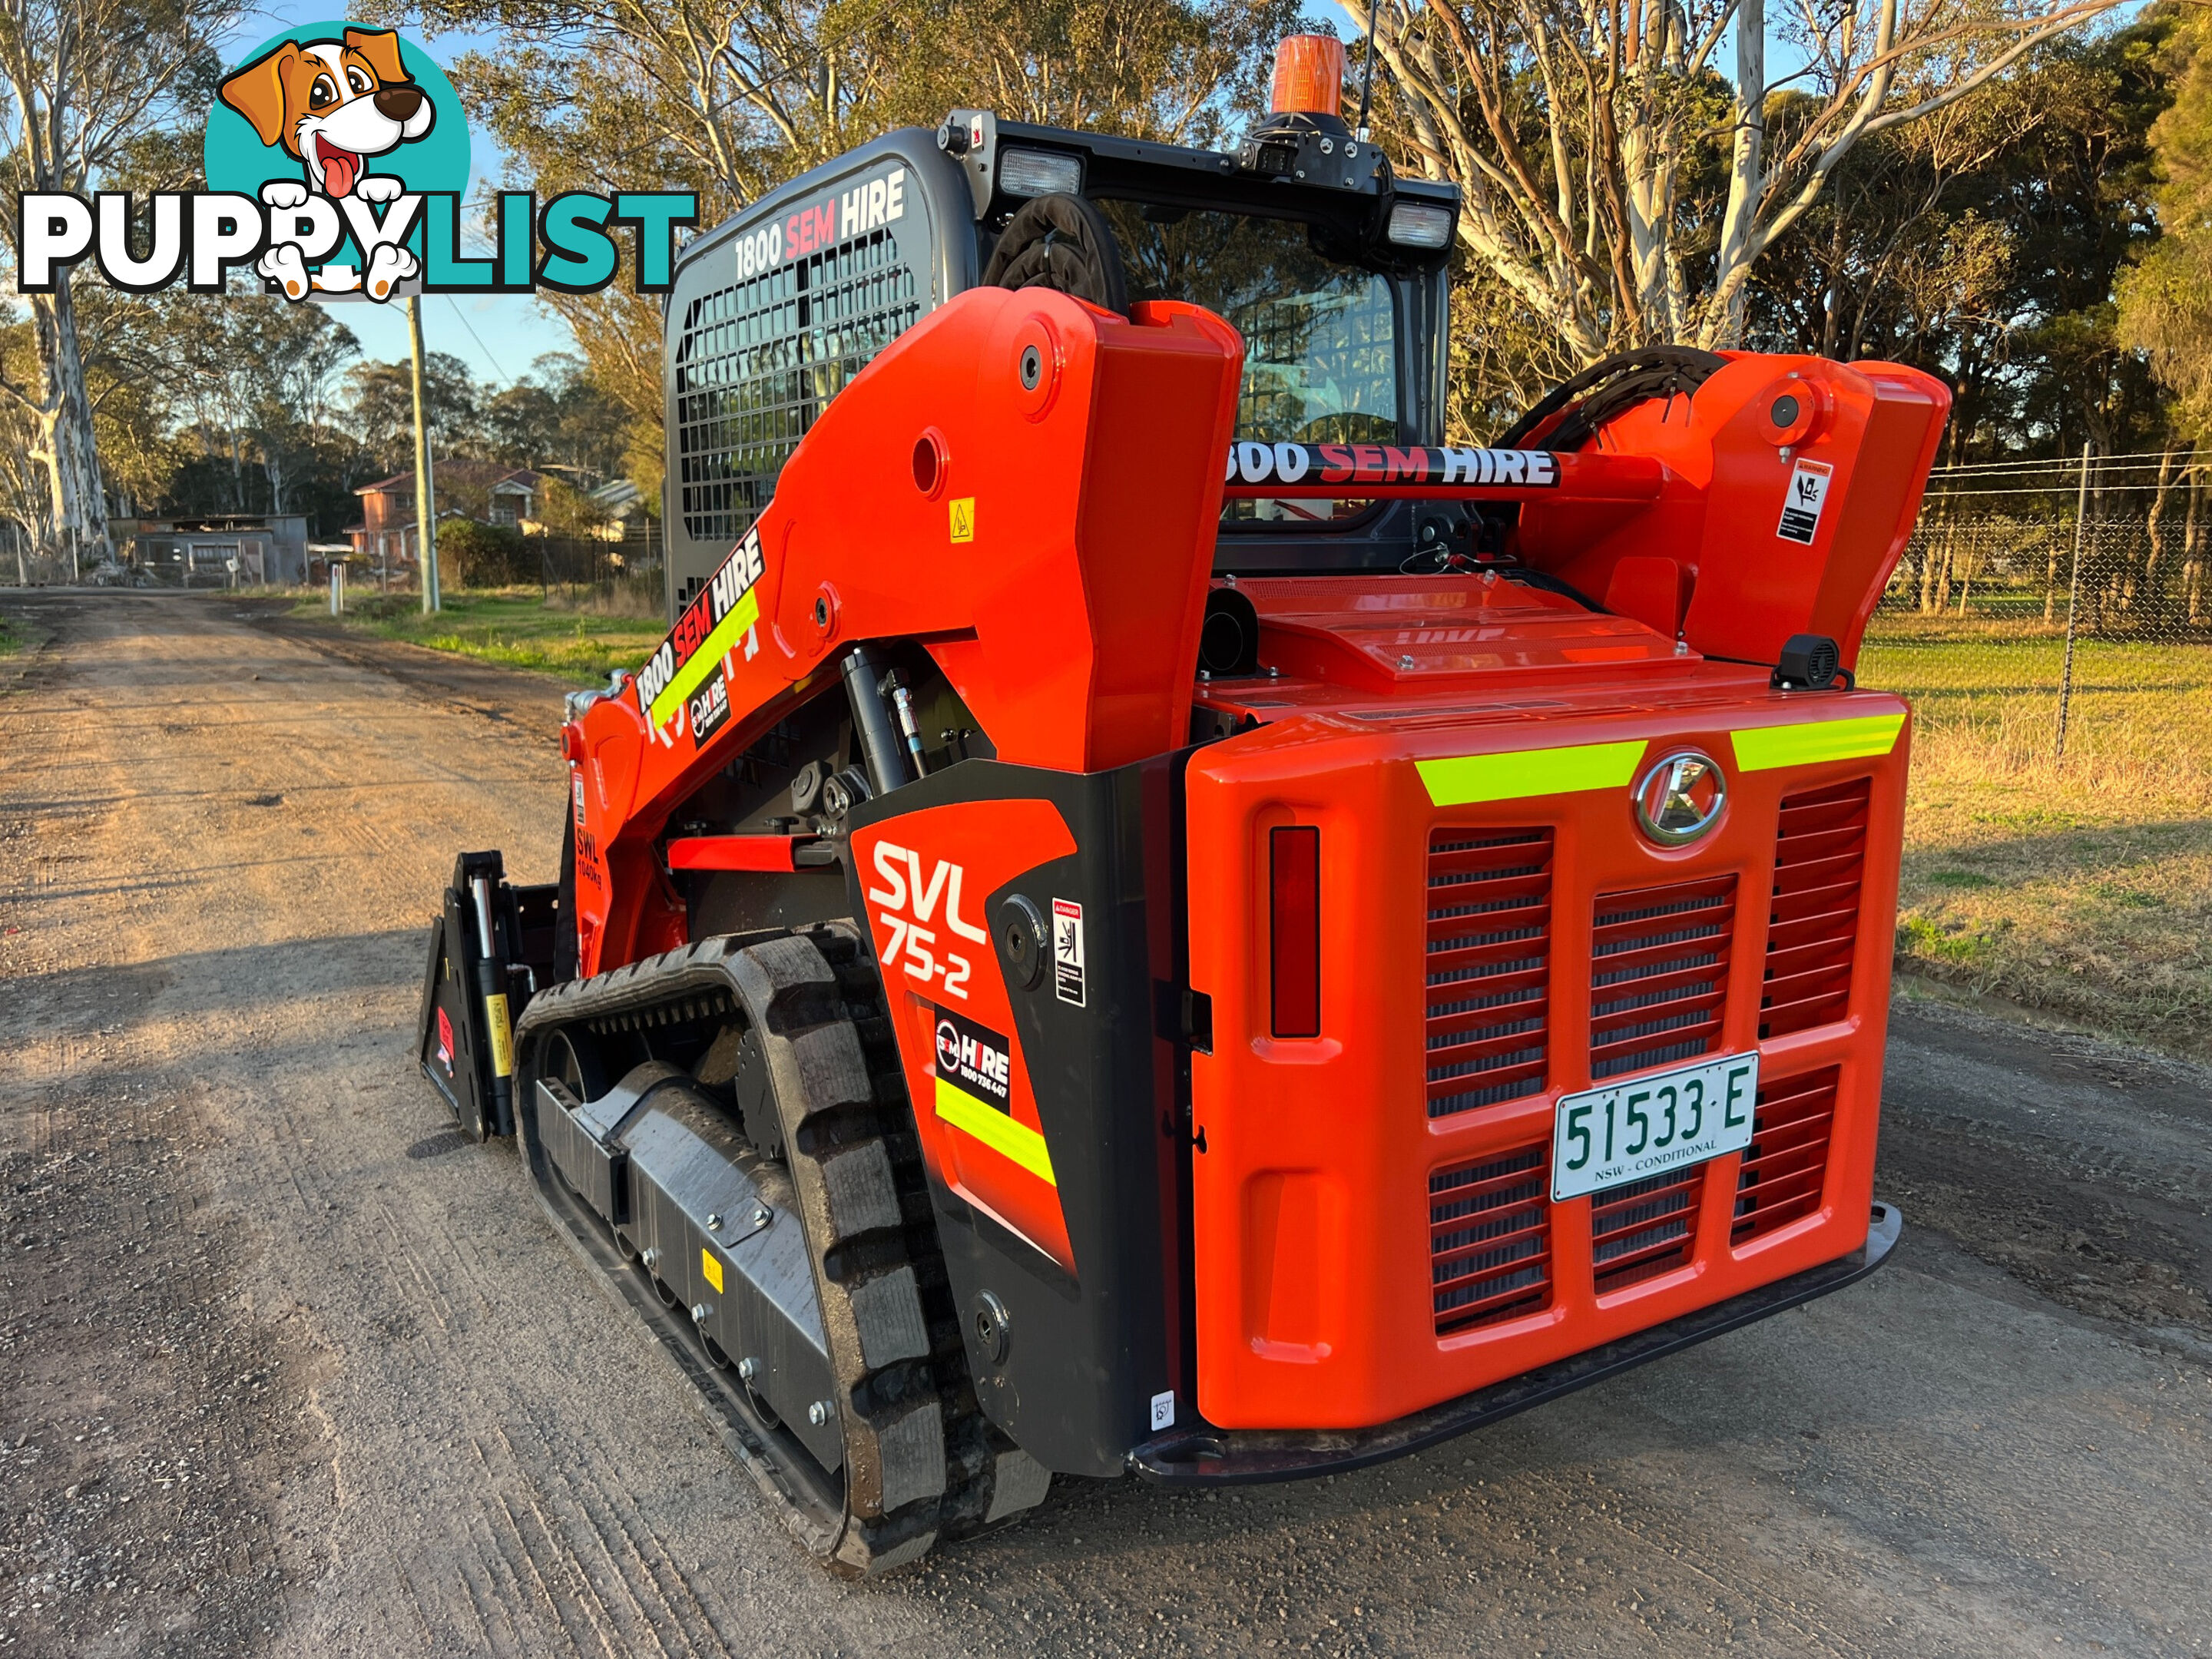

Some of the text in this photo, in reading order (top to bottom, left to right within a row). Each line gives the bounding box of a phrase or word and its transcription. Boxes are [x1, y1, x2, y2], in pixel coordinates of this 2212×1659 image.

[735, 168, 905, 280] 1800 SEM HIRE
[1318, 442, 1429, 482] SEM
[1439, 446, 1555, 484] HIRE
[637, 641, 673, 714] 1800
[674, 591, 712, 667] SEM
[712, 528, 762, 622] HIRE
[700, 674, 727, 718] HIRE
[577, 828, 598, 864] SWL
[869, 839, 986, 945] SVL
[880, 912, 971, 1000] 75-2
[938, 1035, 1009, 1085] SEM HIRE
[1594, 1165, 1624, 1182] NSW
[1635, 1139, 1717, 1171] CONDITIONAL
